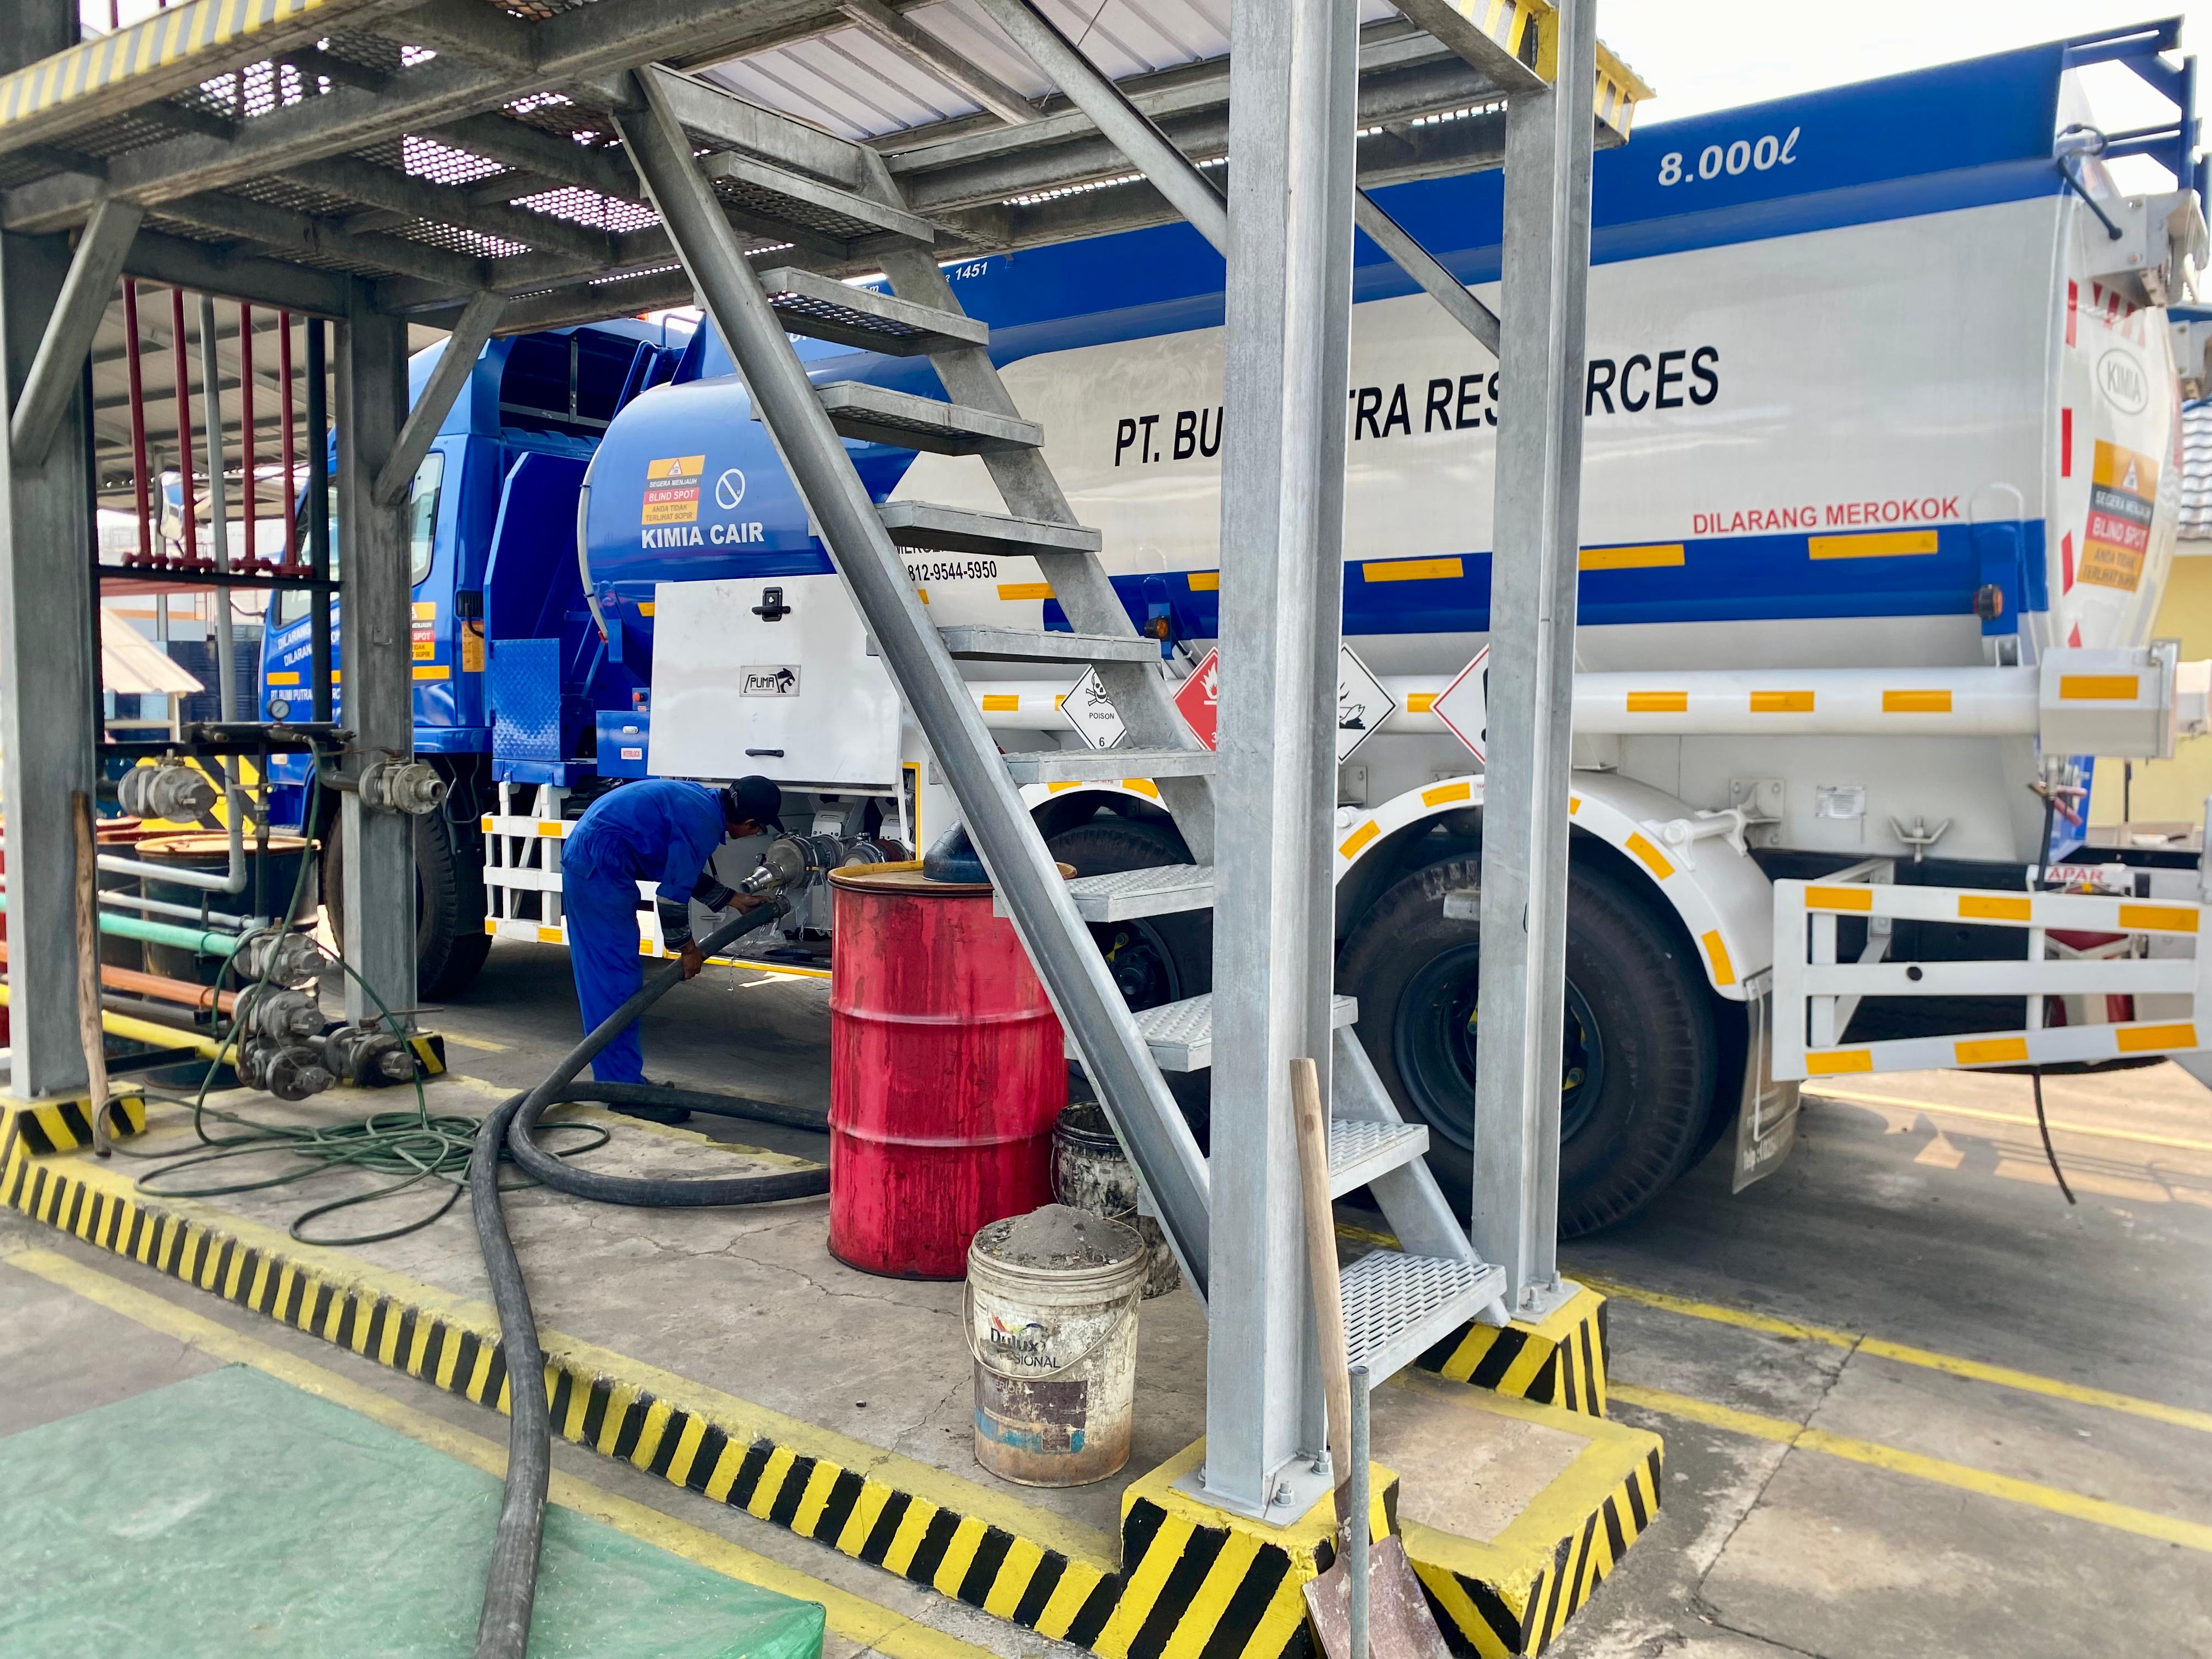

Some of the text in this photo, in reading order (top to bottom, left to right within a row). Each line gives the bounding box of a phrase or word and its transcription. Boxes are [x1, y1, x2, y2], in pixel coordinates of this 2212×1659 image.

[956, 262, 988, 280] 1451
[2108, 360, 2142, 403] KIMIA
[1115, 414, 1159, 466] PT.
[1173, 406, 1223, 458] BU
[1425, 346, 1719, 433] RESRCES
[671, 478, 697, 486] MENJAUH
[648, 489, 695, 501] BLIND SPOT
[646, 513, 674, 521] TERLIHAT
[1694, 495, 1960, 534] DILARANG MEROKOK
[641, 522, 765, 549] KIMIA CAIR
[2092, 516, 2147, 548] BLIND SPOT
[413, 632, 431, 641] SPOT
[283, 644, 312, 667] DILARAN
[750, 677, 774, 688] PUMA
[1099, 737, 1105, 747] 6
[1211, 731, 1217, 743] 3
[2048, 867, 2103, 882] APAR
